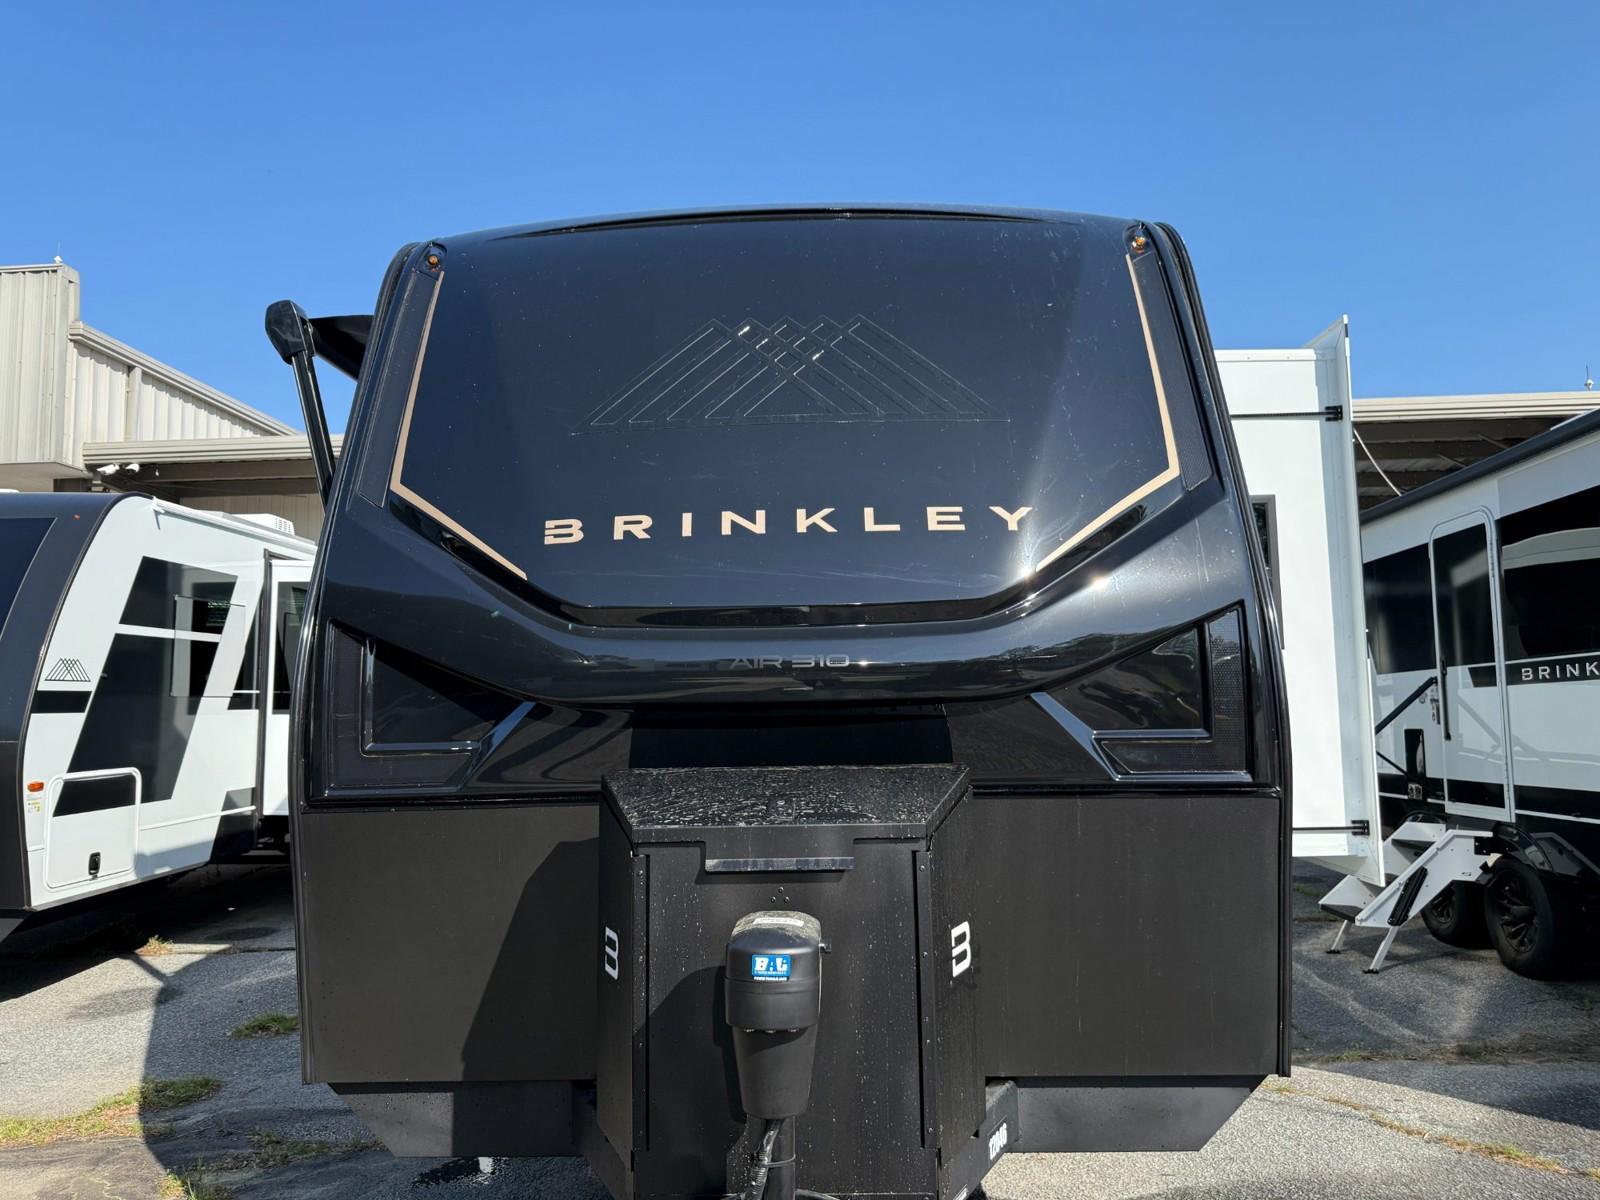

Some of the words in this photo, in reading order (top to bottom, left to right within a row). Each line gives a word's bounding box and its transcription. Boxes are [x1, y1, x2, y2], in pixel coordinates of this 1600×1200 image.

[544, 506, 1033, 545] BRINKLEY
[729, 655, 783, 669] AIR
[791, 654, 850, 668] 310
[1521, 661, 1600, 681] BRINK
[951, 921, 971, 978] B
